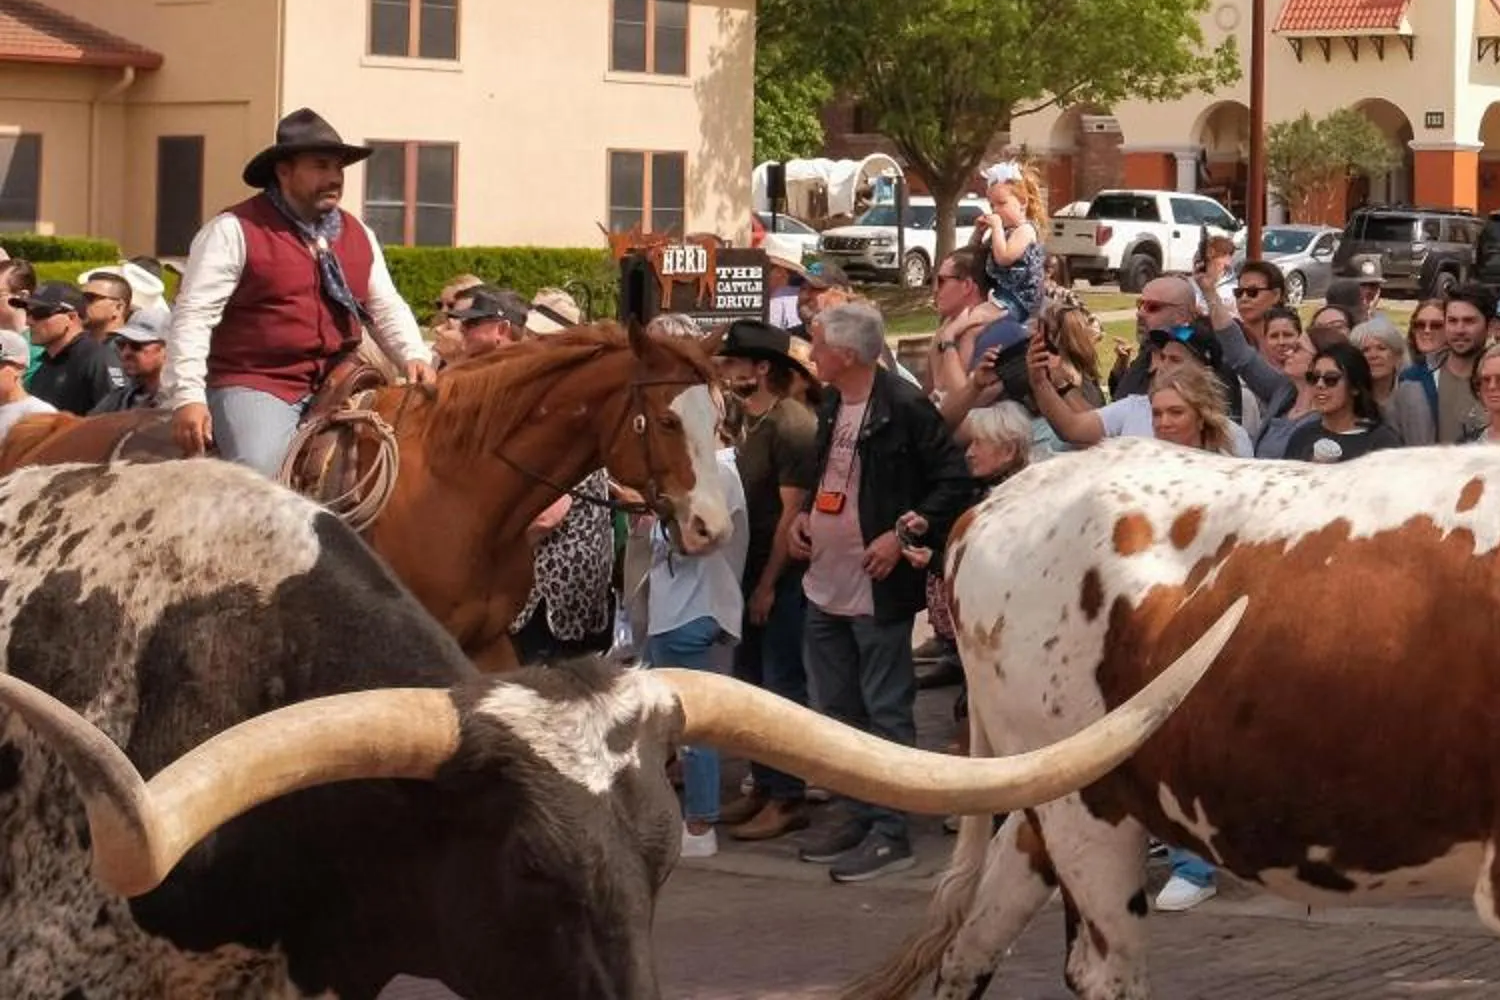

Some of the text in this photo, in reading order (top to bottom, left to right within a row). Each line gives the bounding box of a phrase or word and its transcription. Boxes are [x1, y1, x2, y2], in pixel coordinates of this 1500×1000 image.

[662, 249, 707, 274] HERD
[716, 267, 762, 279] THE
[717, 281, 763, 293] CATTLE
[716, 296, 763, 309] DRIVE
